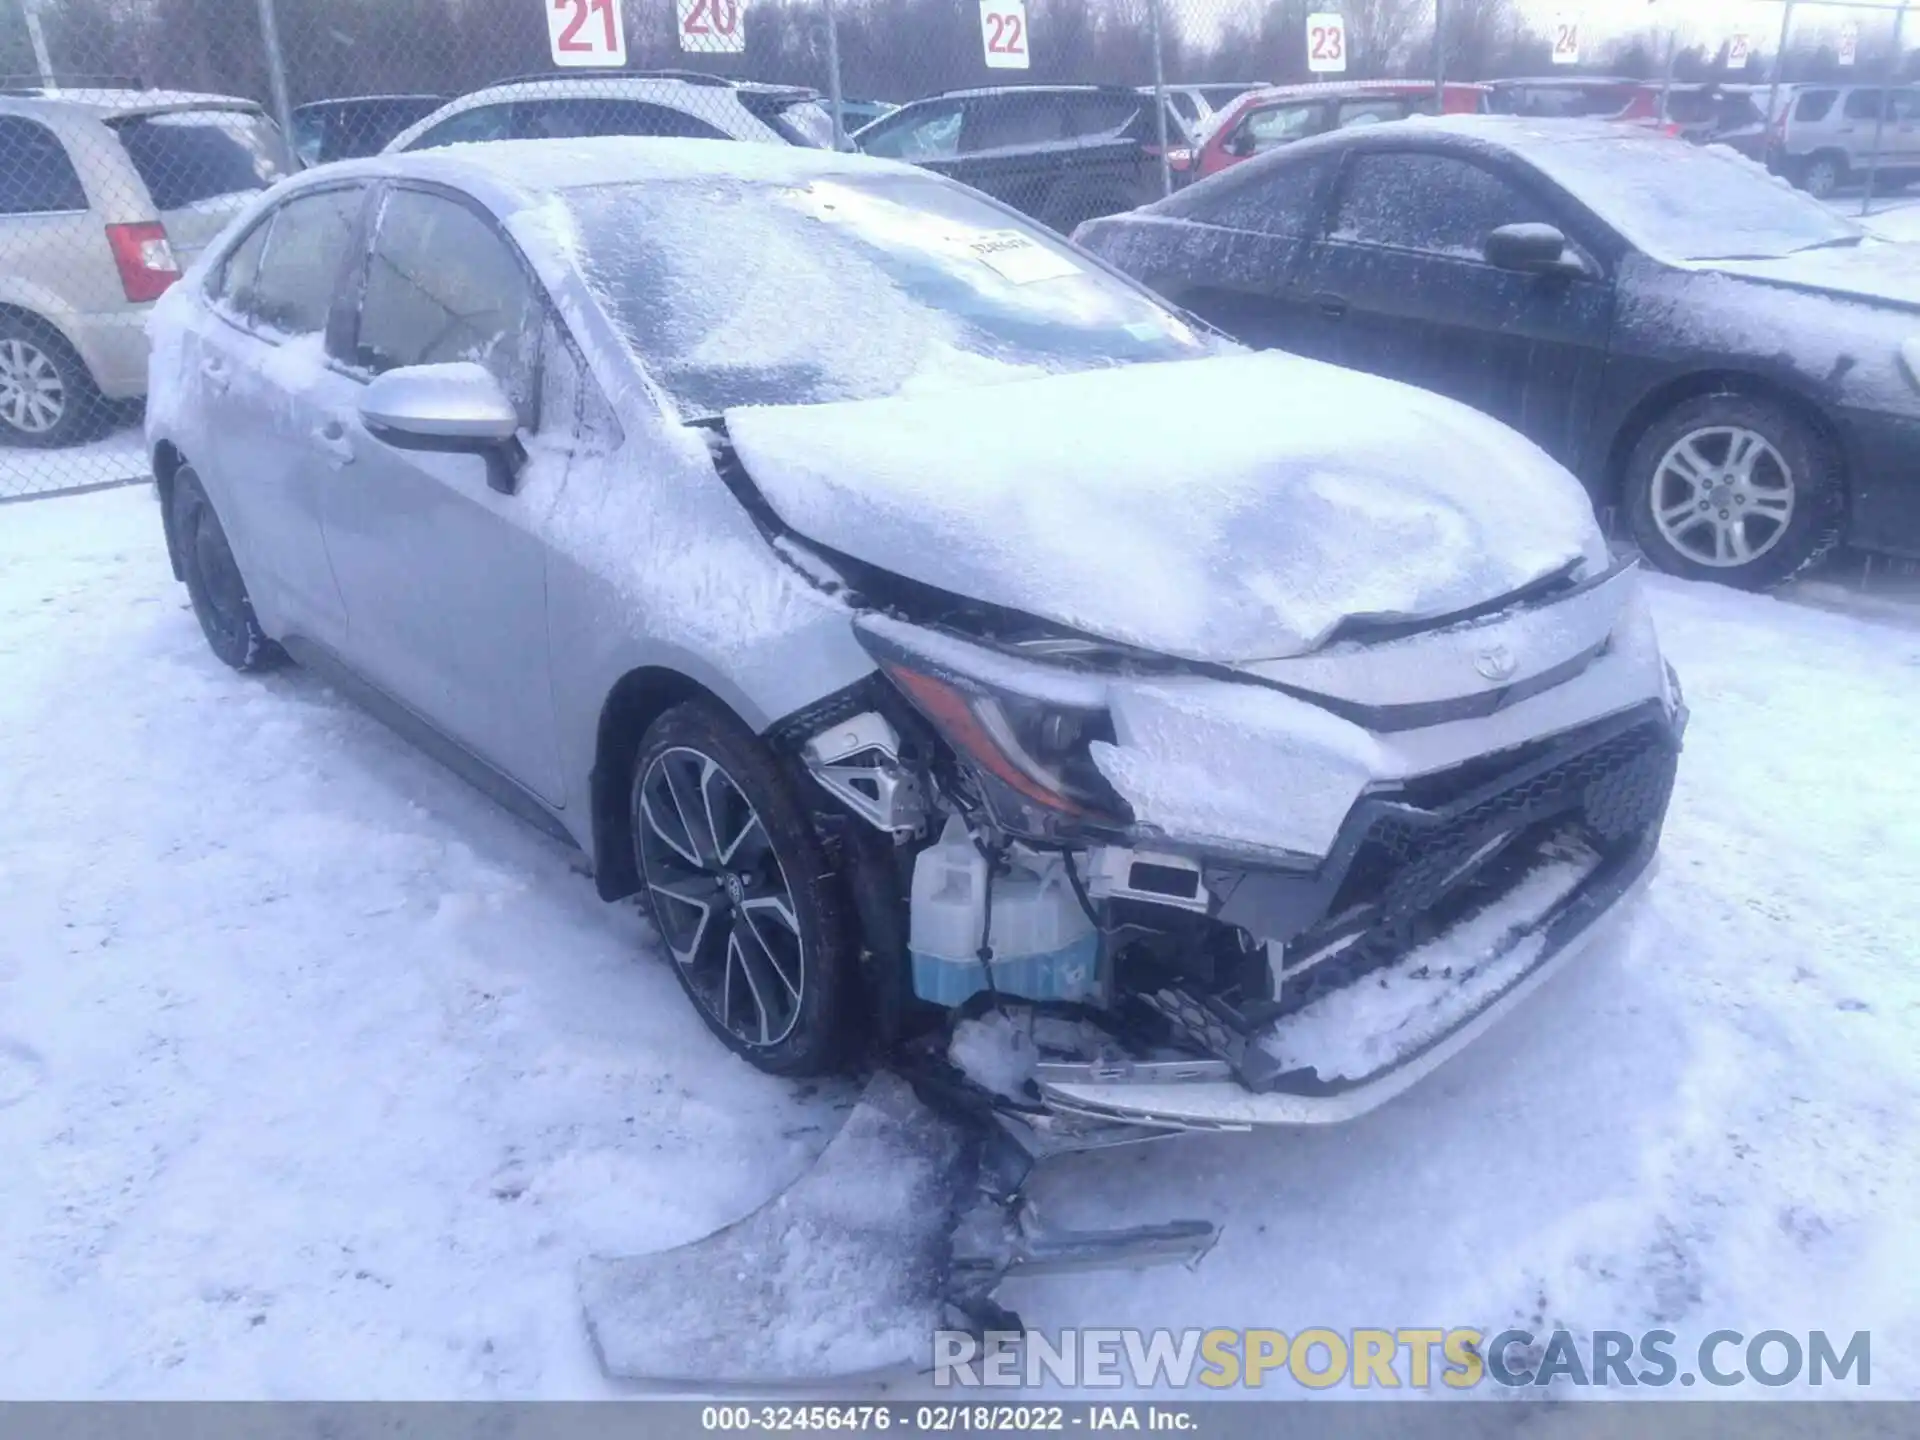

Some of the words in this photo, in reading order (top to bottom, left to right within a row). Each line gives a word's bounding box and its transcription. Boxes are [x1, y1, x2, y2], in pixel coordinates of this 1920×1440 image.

[554, 0, 618, 51] 21
[683, 0, 736, 35] 20
[986, 12, 1024, 54] 22
[1311, 26, 1341, 60] 23
[1556, 23, 1577, 53] 24
